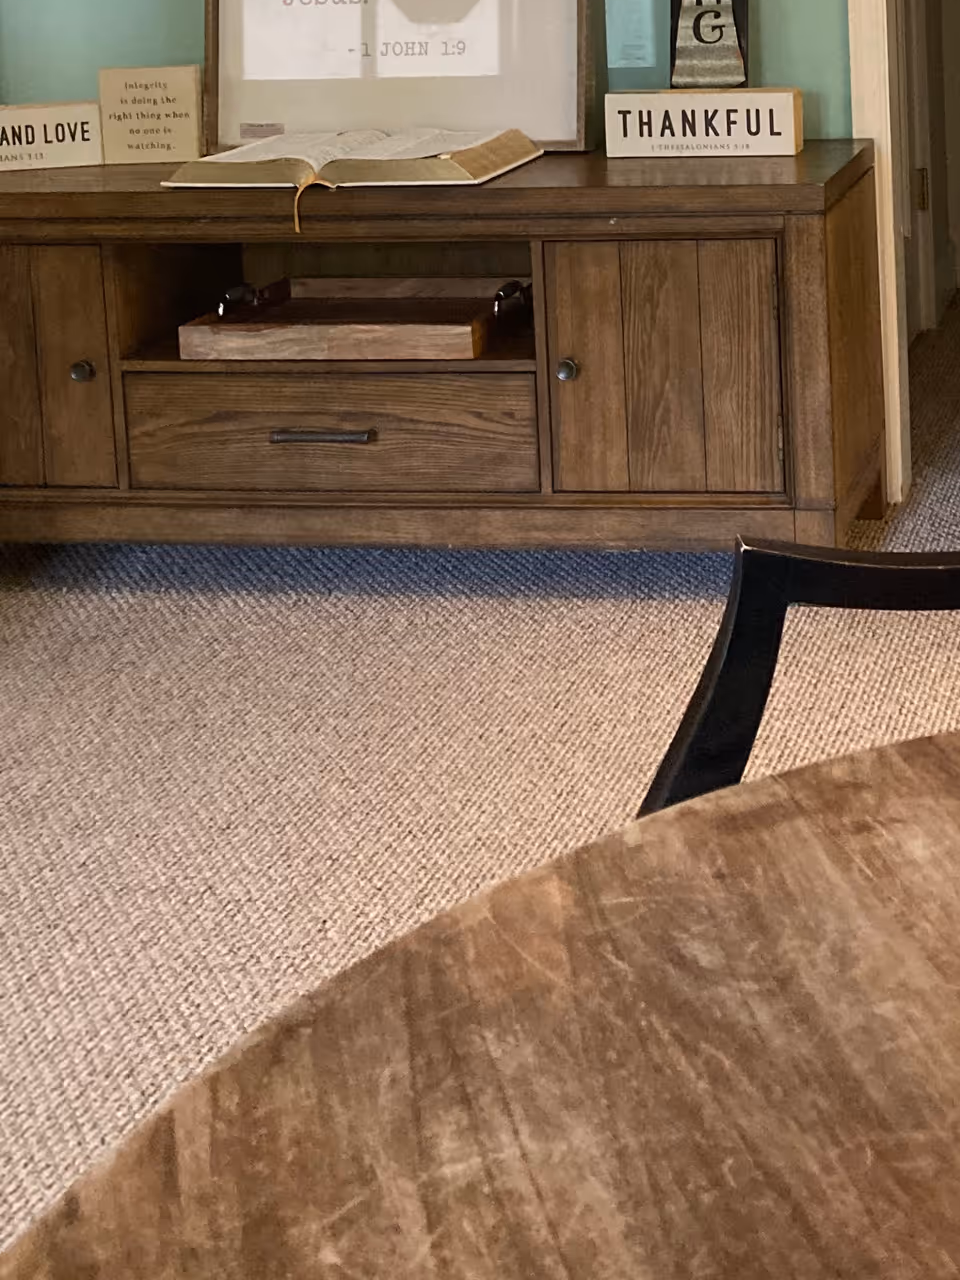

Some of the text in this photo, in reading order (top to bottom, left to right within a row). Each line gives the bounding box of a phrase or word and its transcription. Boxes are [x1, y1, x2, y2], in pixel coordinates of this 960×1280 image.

[380, 42, 429, 57] JOHN
[441, 40, 466, 56] 1:9
[124, 81, 168, 92] Integrity
[120, 95, 177, 106] is doing the
[108, 110, 190, 122] right thing when
[617, 107, 782, 139] THANKFUL
[0, 121, 91, 147] AND LOVE
[658, 142, 730, 151] THESSALONIANS
